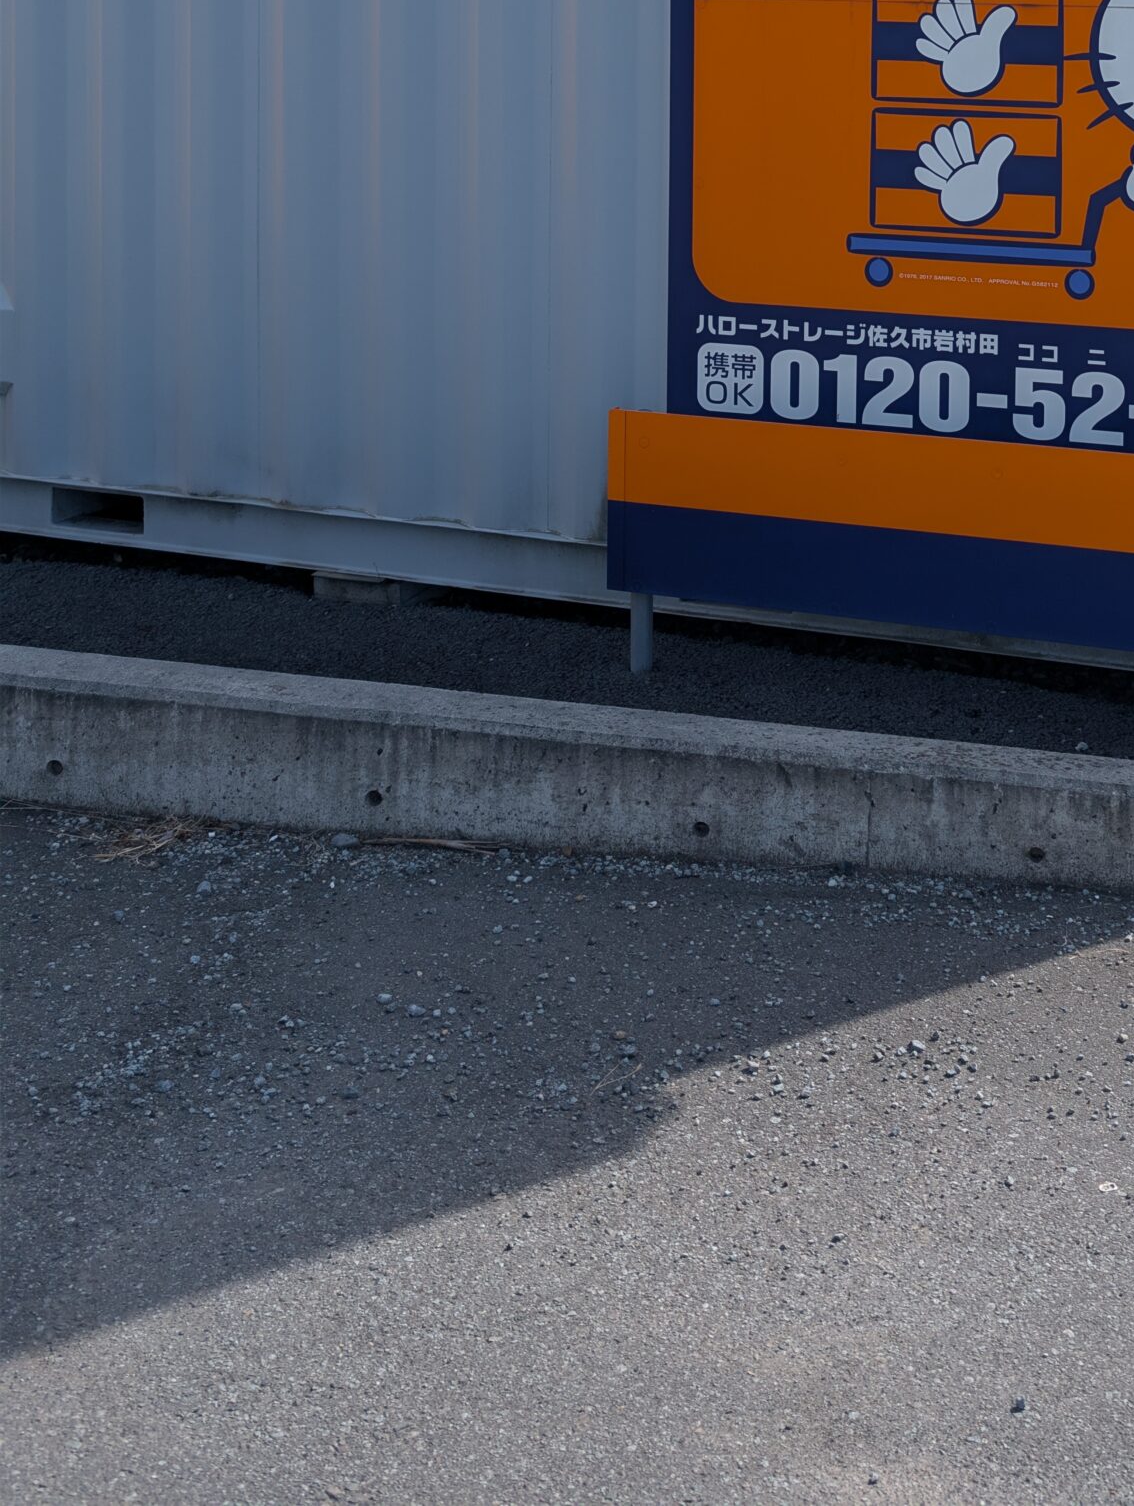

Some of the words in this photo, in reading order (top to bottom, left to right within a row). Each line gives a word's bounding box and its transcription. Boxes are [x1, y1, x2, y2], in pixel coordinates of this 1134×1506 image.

[988, 277, 1020, 286] APPROVAL
[696, 314, 999, 356] ハローストレージ佐久市岩村田
[704, 352, 757, 381] 携帯
[1088, 350, 1107, 366] ニ
[705, 378, 753, 407] OK
